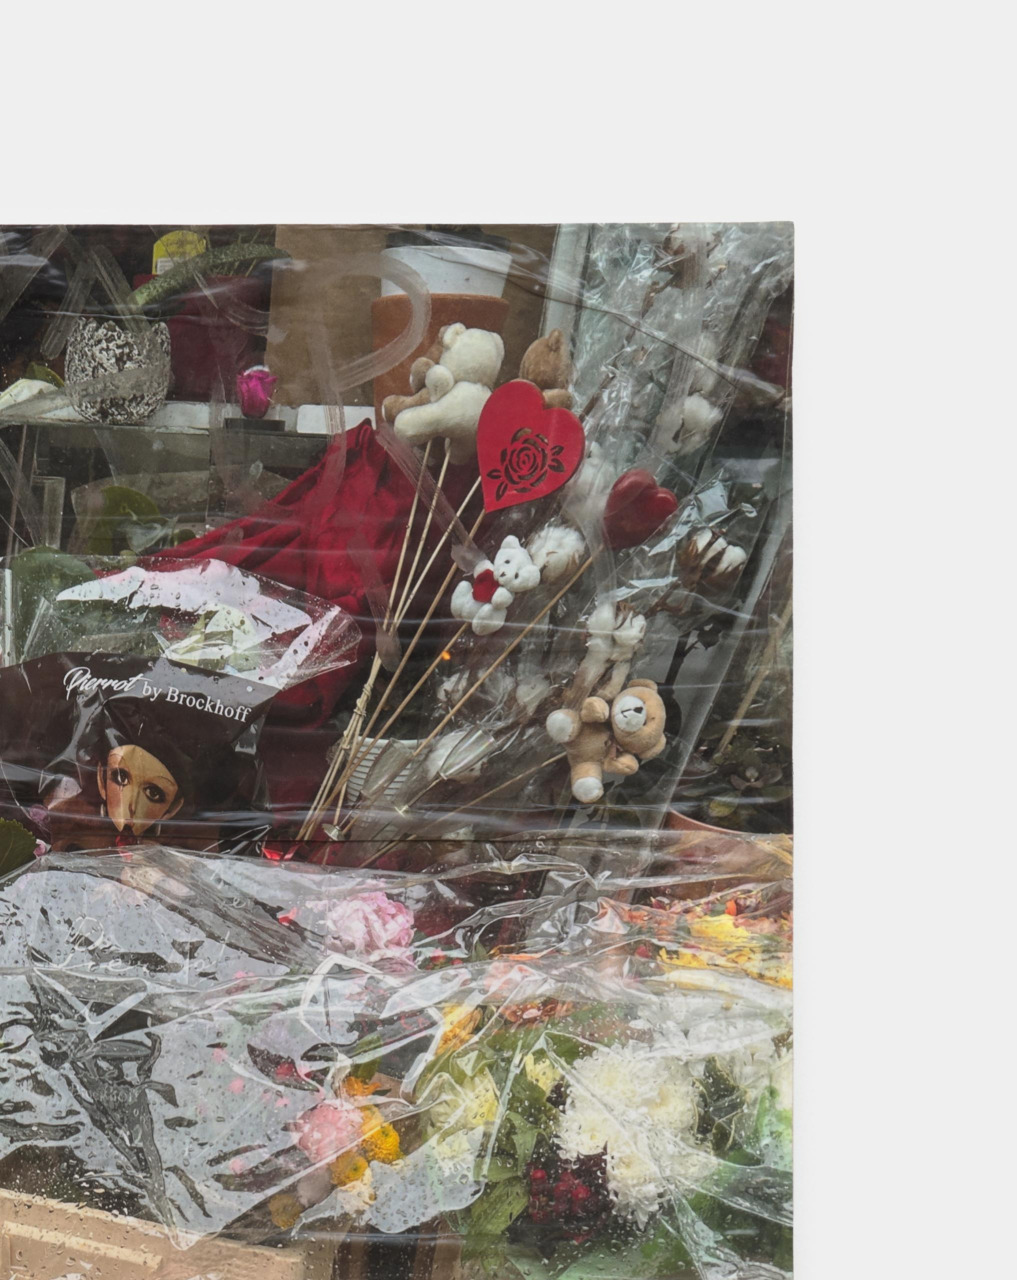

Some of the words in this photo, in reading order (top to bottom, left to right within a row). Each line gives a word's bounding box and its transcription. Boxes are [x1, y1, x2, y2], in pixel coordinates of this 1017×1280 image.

[63, 666, 152, 701] Pierrot
[142, 681, 162, 702] by
[165, 686, 252, 722] Brockhoff
